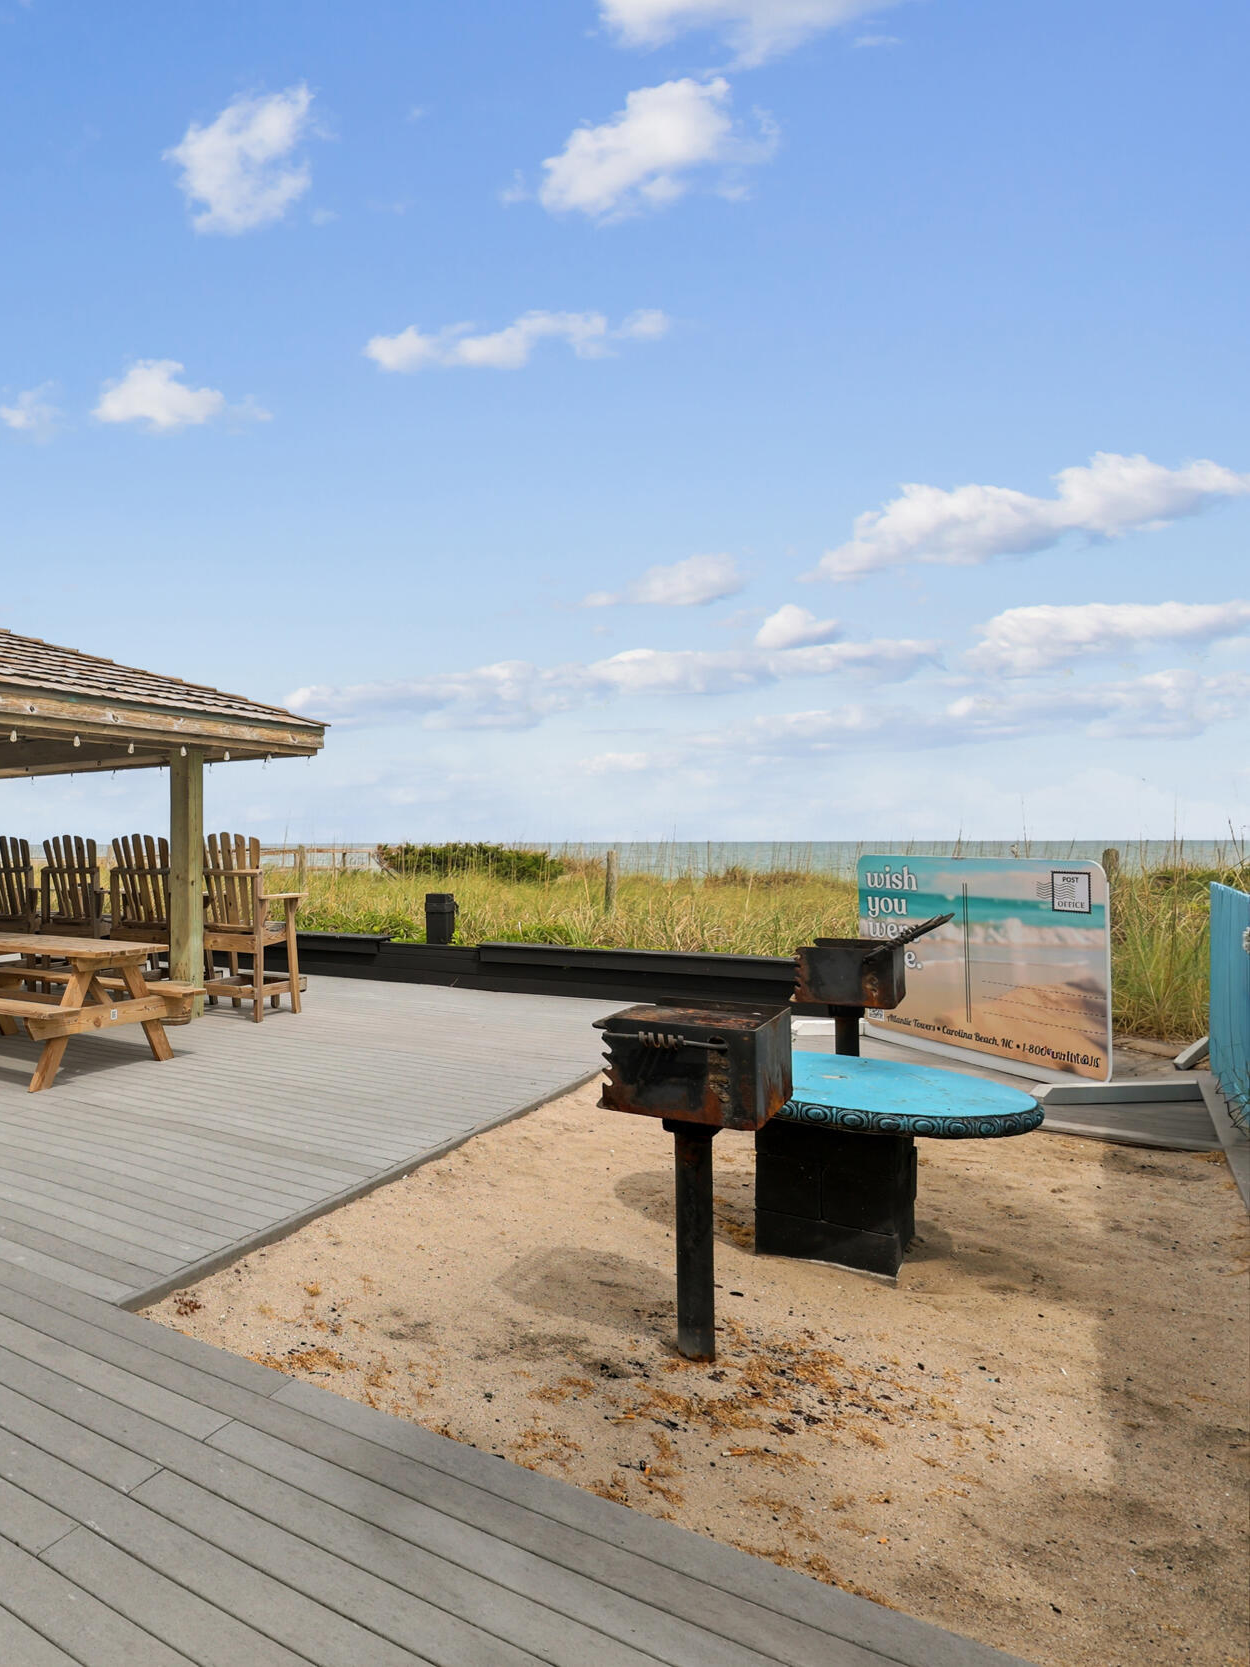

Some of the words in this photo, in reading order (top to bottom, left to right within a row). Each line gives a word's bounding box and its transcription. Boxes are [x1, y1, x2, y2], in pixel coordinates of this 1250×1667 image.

[866, 865, 918, 892] wish
[1062, 876, 1079, 884] POST
[867, 895, 907, 917] you
[1057, 900, 1085, 909] OFFICE
[869, 921, 920, 943] wer
[913, 1018, 936, 1032] Towers
[942, 1025, 973, 1040] Carolina
[1001, 1038, 1014, 1050] NC
